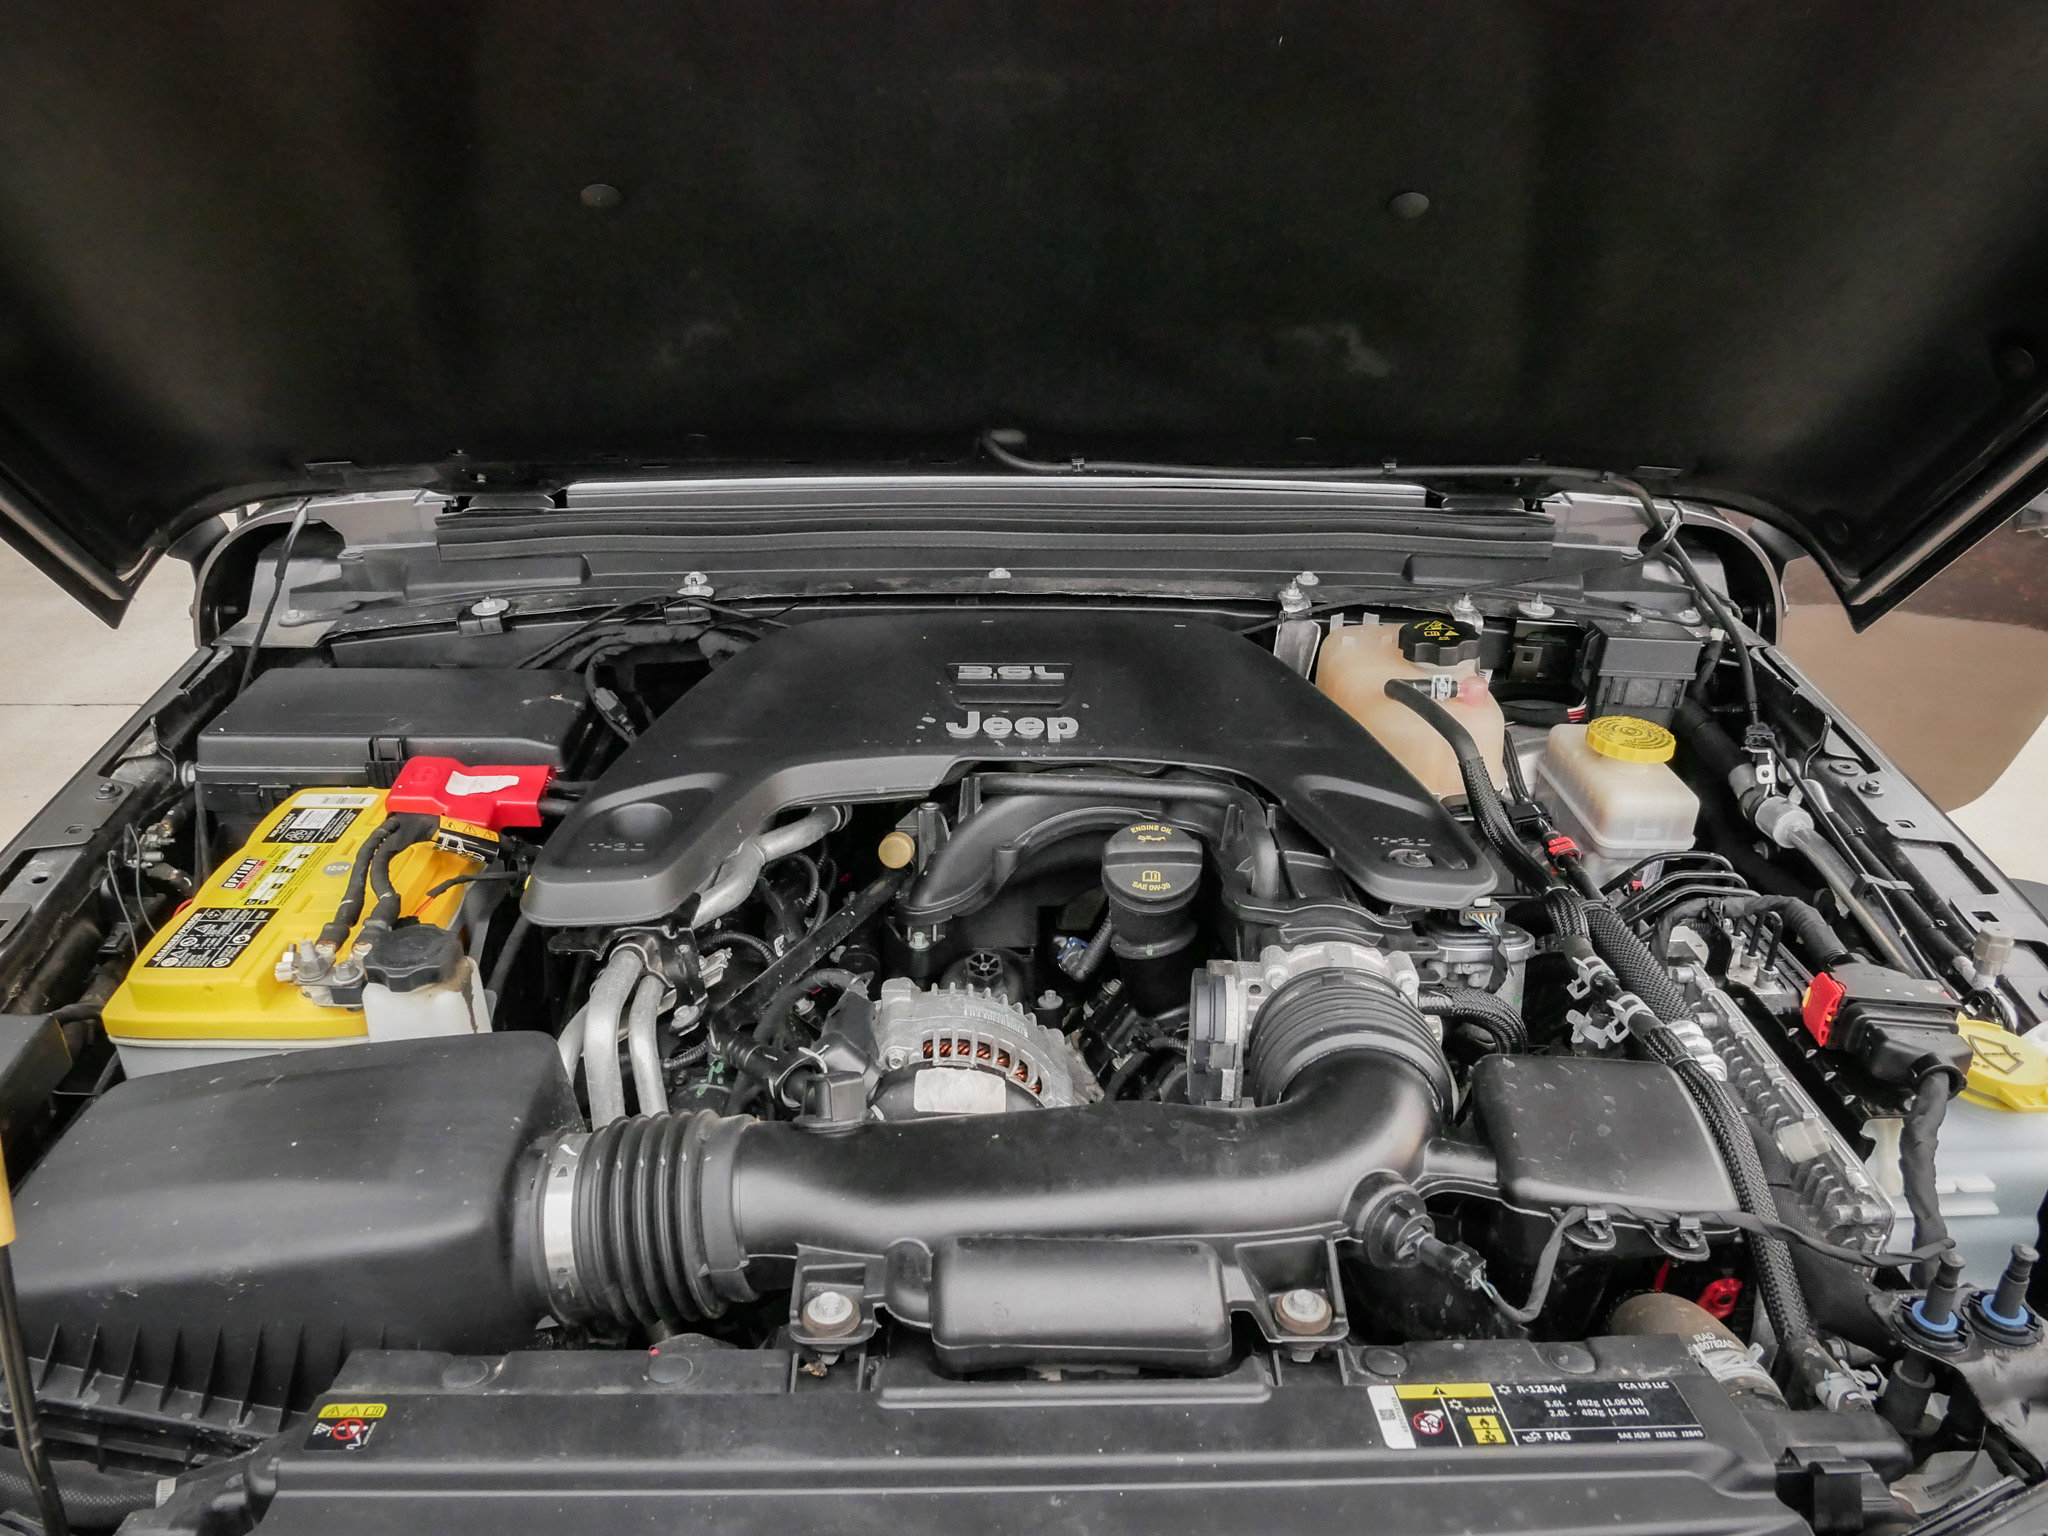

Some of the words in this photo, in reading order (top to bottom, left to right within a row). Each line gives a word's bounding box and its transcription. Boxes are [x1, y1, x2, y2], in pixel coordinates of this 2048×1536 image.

[957, 665, 1065, 680] 3.6L
[945, 711, 1079, 743] Jeep
[1131, 824, 1160, 834] ENGINE
[1161, 826, 1172, 835] OIL
[223, 858, 260, 889] OPTIMA
[1132, 881, 1148, 891] SAE
[1149, 882, 1171, 891] 0W-20
[1693, 1332, 1716, 1342] RAD
[1516, 1384, 1567, 1395] R-1234yf
[1618, 1382, 1638, 1390] FCA
[1652, 1381, 1670, 1389] LLC
[1544, 1400, 1566, 1408] 3.6L
[1576, 1399, 1601, 1409] 482g
[1602, 1398, 1627, 1408] (1.06
[1628, 1397, 1644, 1407] Lb)
[1549, 1409, 1571, 1418] 2.0L
[1581, 1408, 1606, 1418] 482g
[1607, 1407, 1632, 1417] (1.06
[1633, 1407, 1650, 1416] Lb)
[1545, 1431, 1572, 1441] PAG
[1617, 1432, 1633, 1440] SAE
